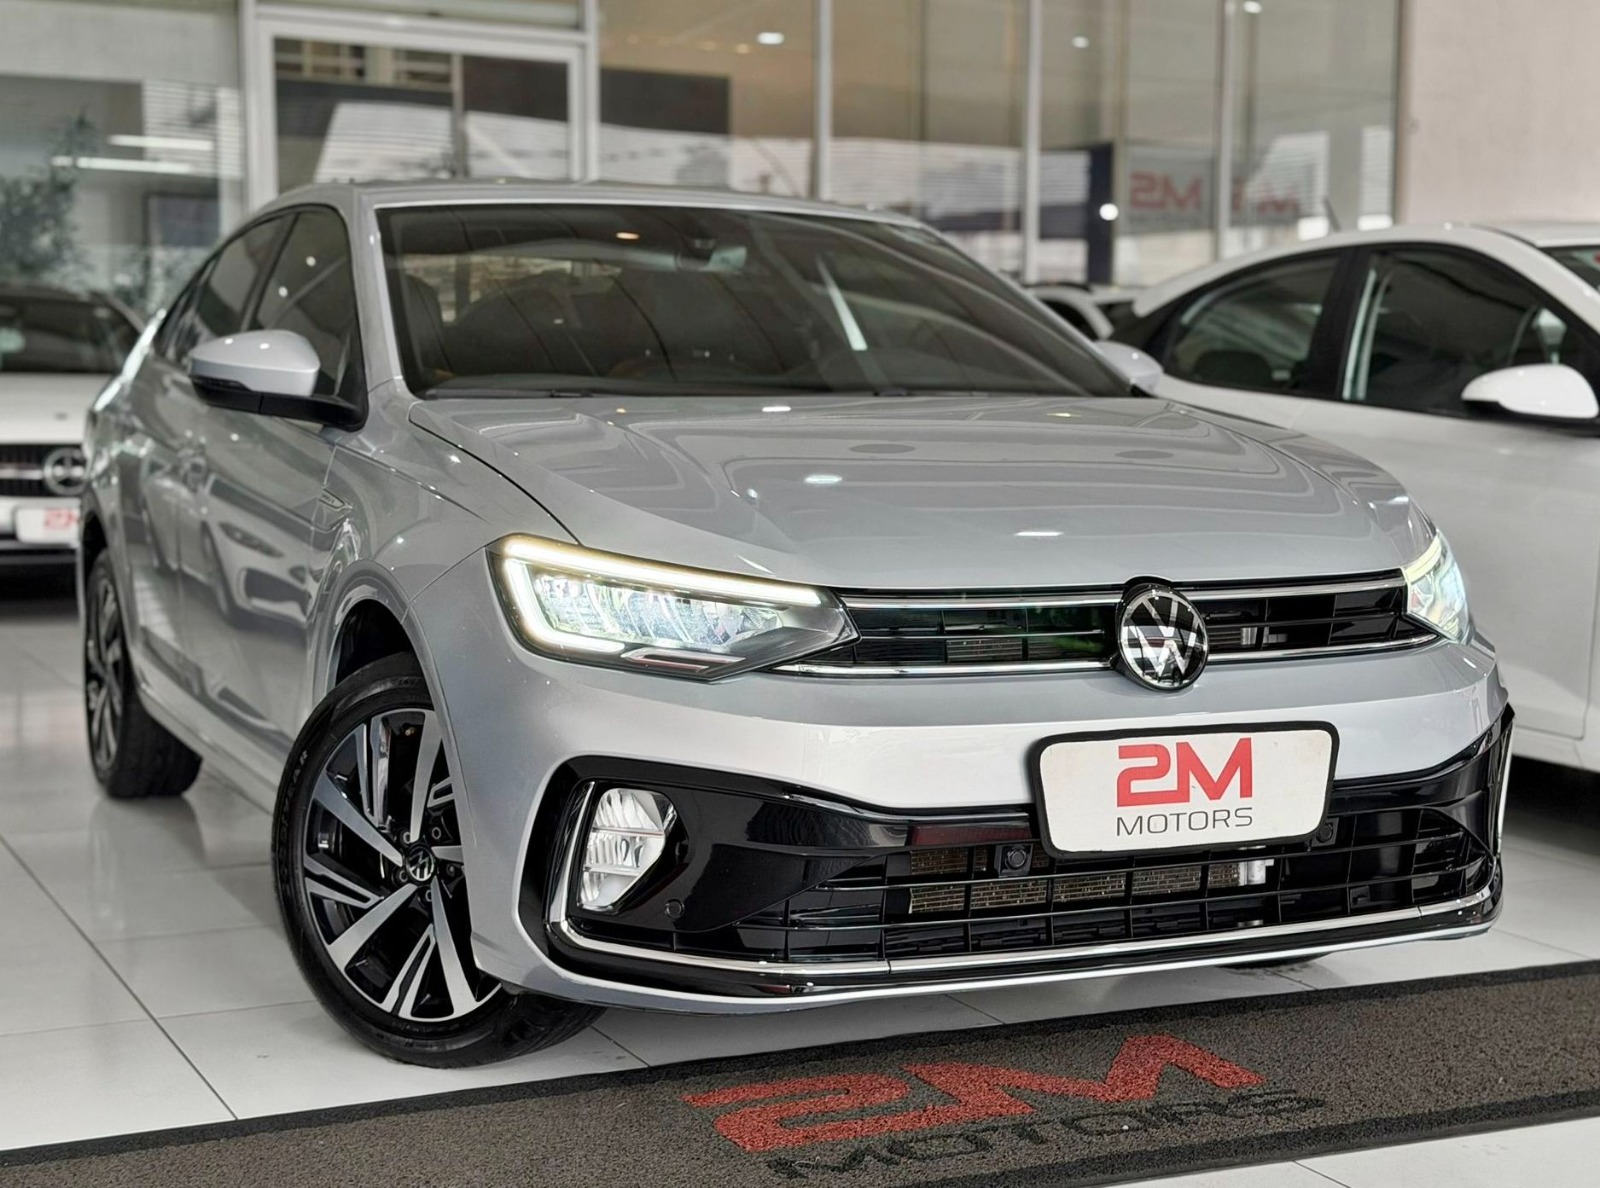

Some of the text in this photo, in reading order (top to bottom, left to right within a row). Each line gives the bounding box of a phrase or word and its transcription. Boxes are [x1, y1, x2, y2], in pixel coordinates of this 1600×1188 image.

[1116, 737, 1253, 808] 2M
[1116, 807, 1253, 837] MOTORS
[682, 1034, 1267, 1152] 2M
